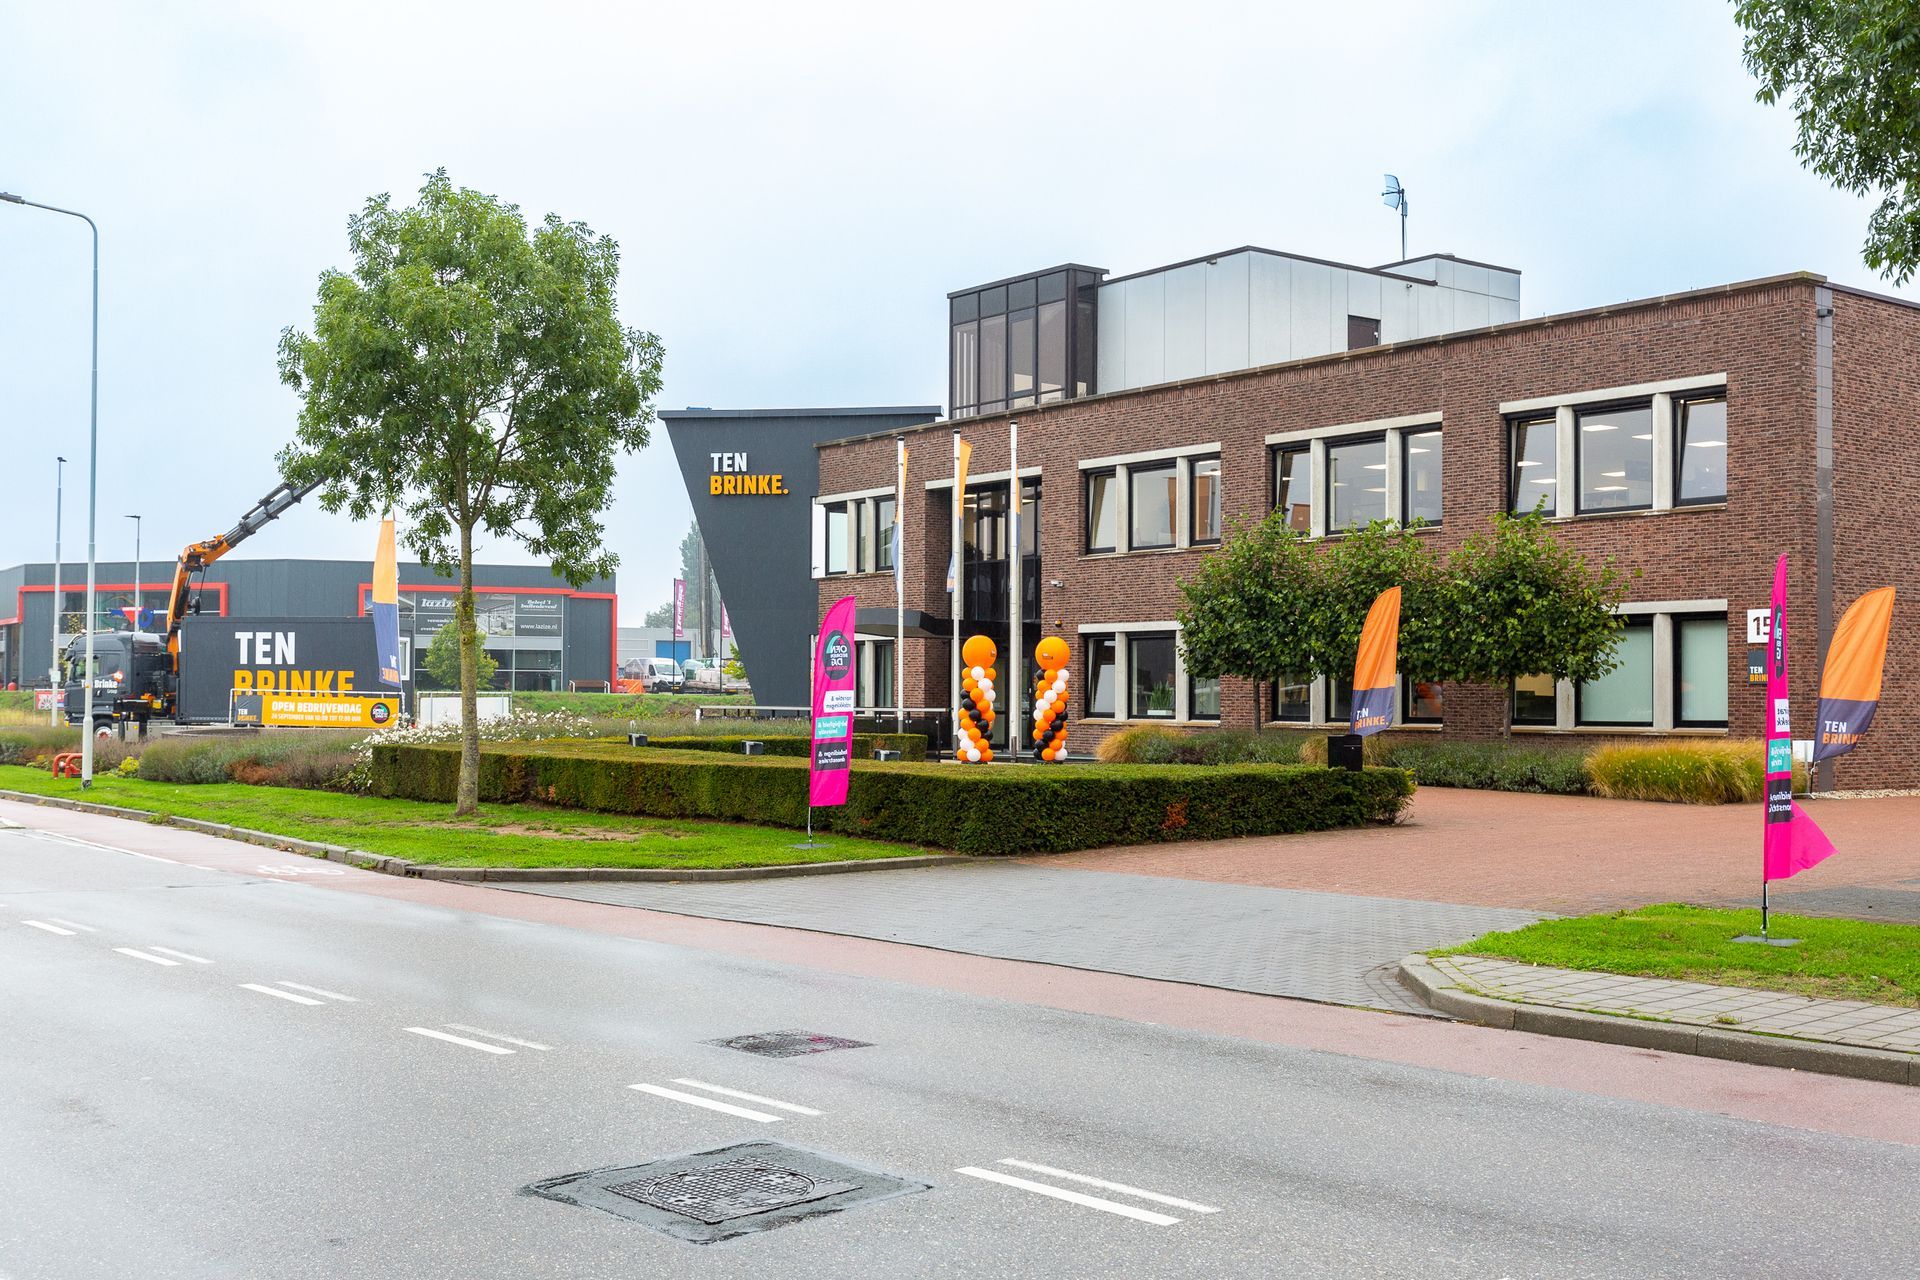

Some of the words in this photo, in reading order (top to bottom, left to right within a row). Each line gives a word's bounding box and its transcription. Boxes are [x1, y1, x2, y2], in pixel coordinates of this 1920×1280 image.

[710, 452, 747, 472] TEN
[710, 474, 789, 495] BRINKE.
[234, 631, 296, 665] TEN
[1750, 666, 1763, 674] TEN
[94, 679, 118, 688] Brinke
[233, 669, 363, 699] BRINKE
[1750, 674, 1768, 682] BRIN
[271, 701, 295, 712] OPEN
[297, 702, 362, 715] BEDRIJVENDAG
[1824, 720, 1847, 733] TEN
